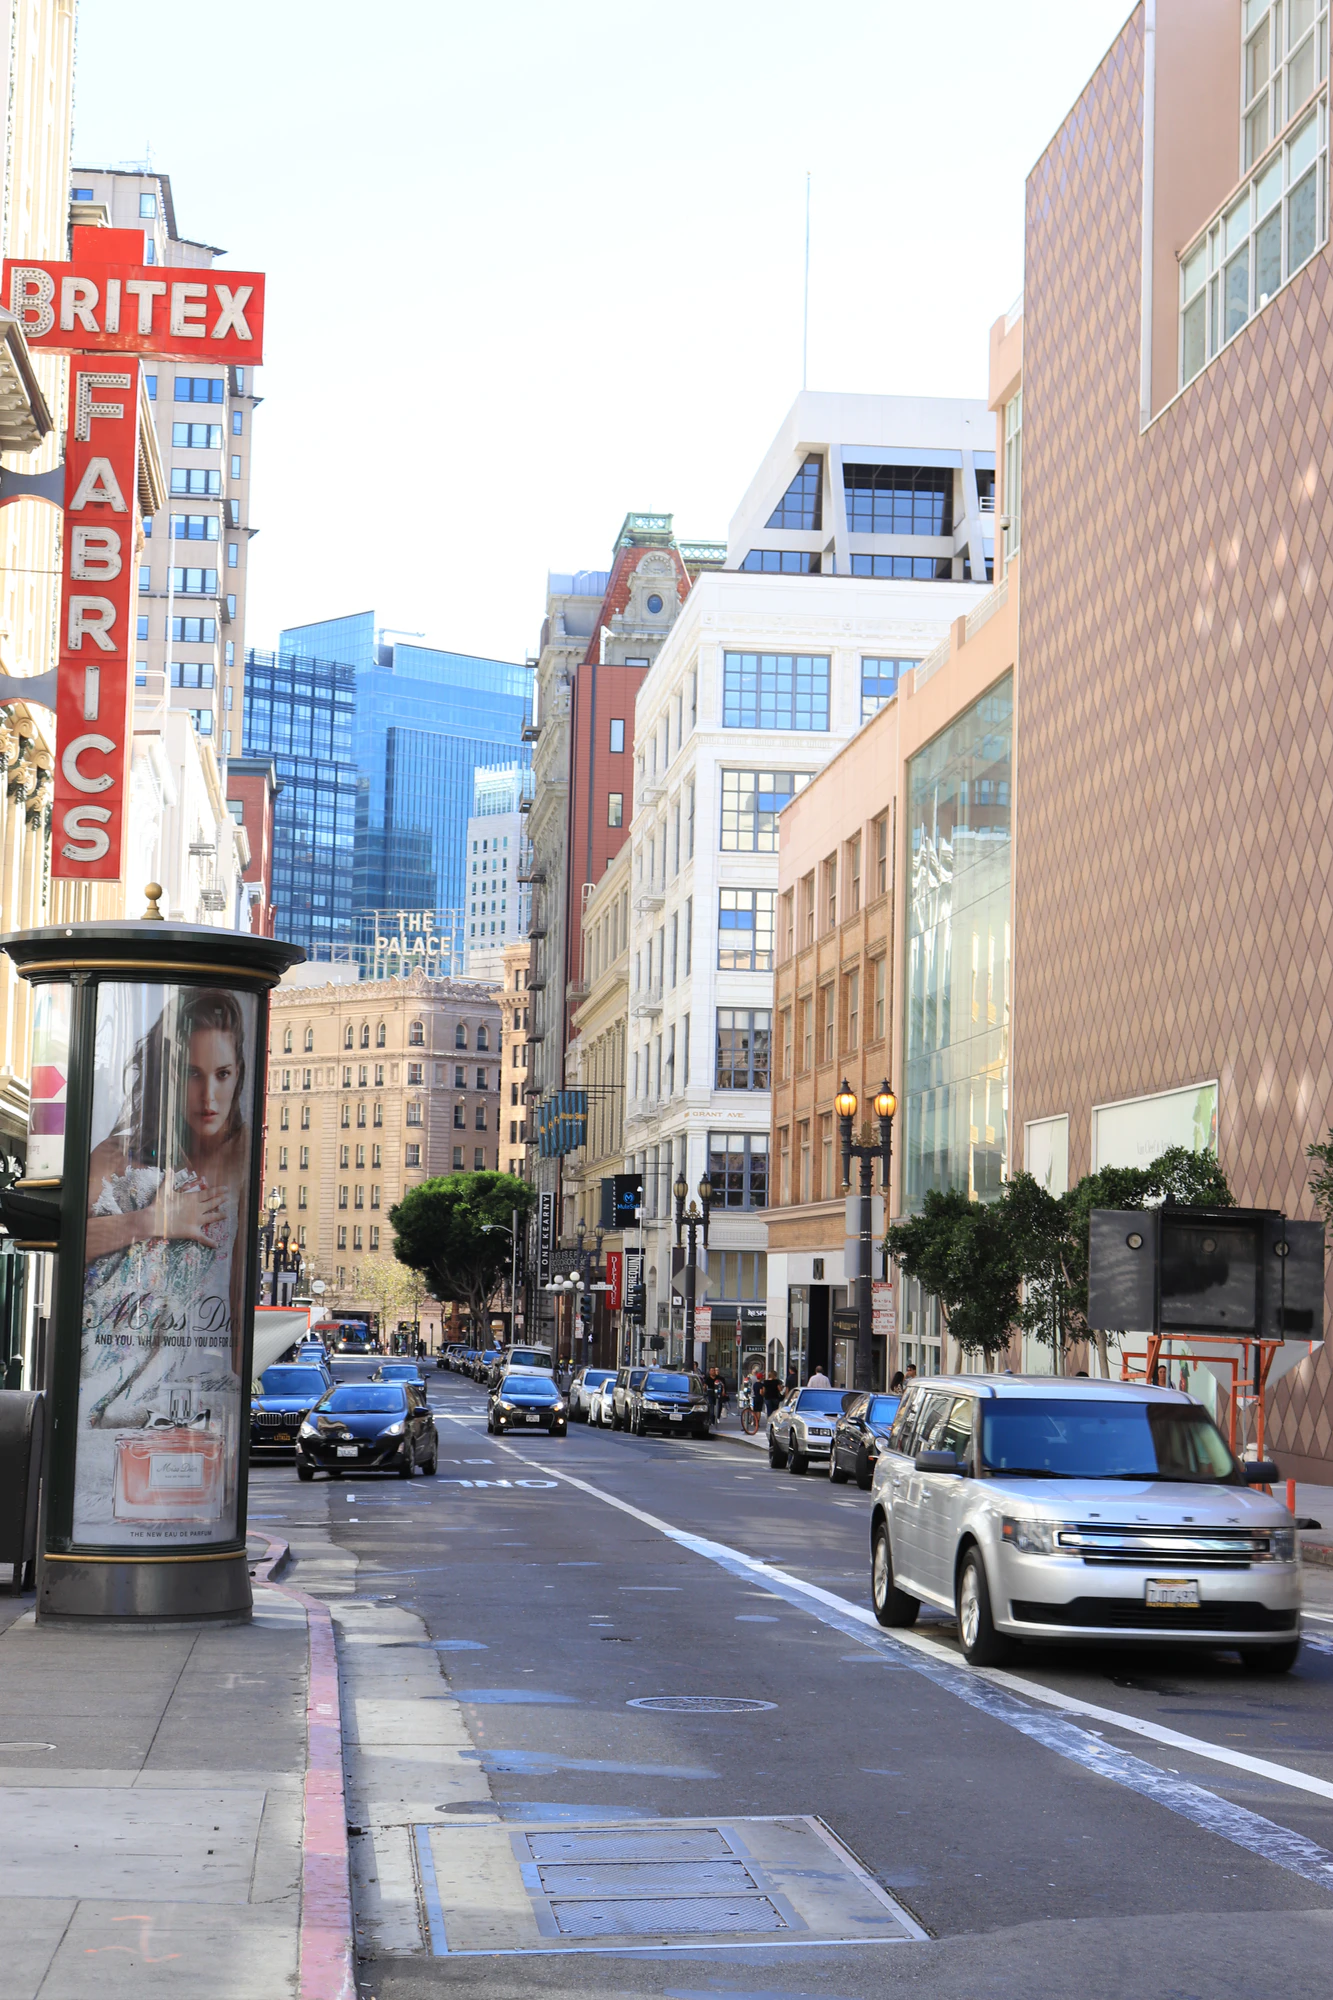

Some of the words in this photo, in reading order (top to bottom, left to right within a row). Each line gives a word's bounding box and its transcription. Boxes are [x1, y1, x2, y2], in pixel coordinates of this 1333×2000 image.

[10, 267, 254, 341] BRITEX
[60, 370, 132, 862] FABRICS
[396, 912, 434, 932] THE
[375, 936, 451, 956] PALACE
[542, 1196, 550, 1239] KEARNY
[541, 1244, 549, 1265] ONE
[86, 1292, 187, 1331] Miss
[95, 1334, 113, 1345] AND
[163, 1336, 192, 1347] WOULD
[194, 1336, 208, 1347] YOU
[208, 1336, 218, 1347] DO
[219, 1337, 229, 1347] FOR
[1089, 1513, 1240, 1523] FLEX
